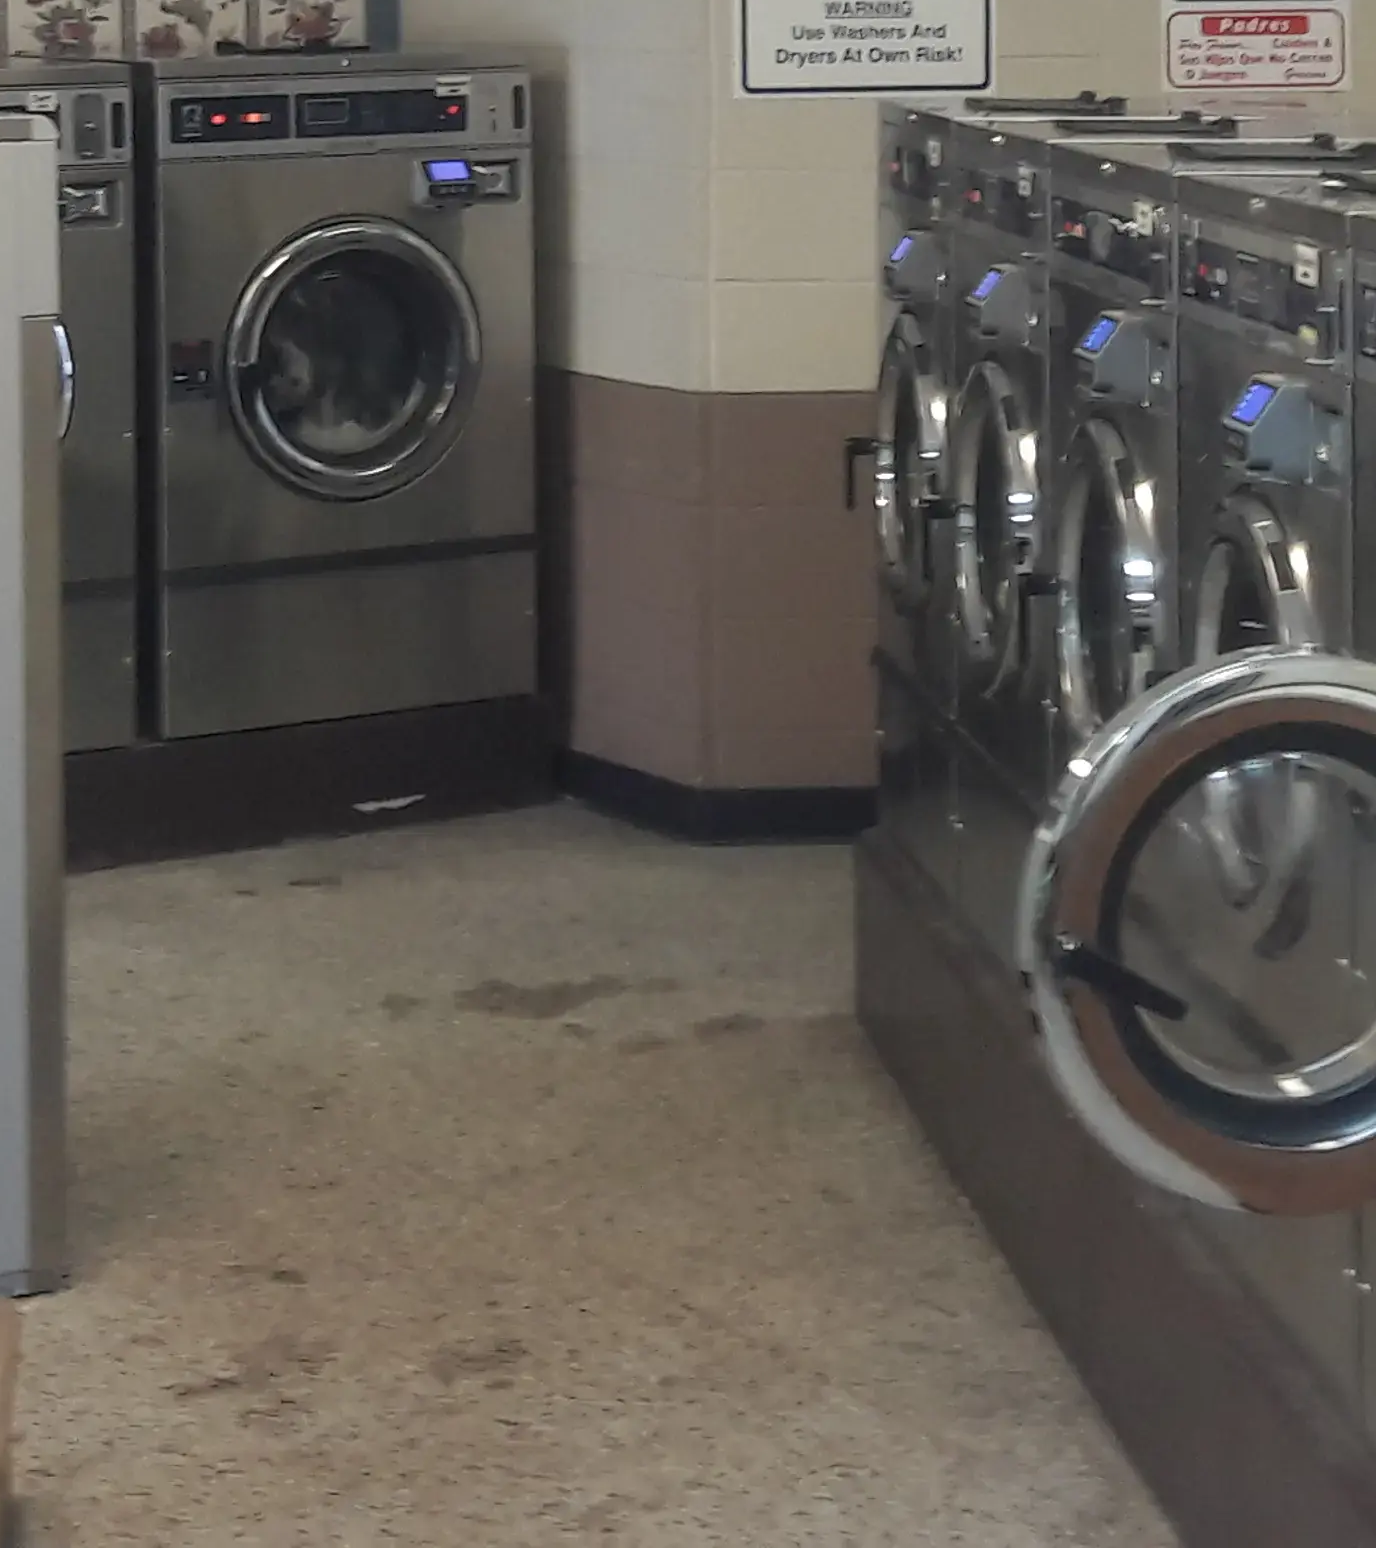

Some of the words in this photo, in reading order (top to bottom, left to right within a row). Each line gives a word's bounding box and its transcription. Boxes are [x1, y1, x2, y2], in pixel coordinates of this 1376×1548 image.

[825, 1, 913, 17] WARNING
[792, 25, 825, 40] Use
[831, 25, 906, 40] Washers
[910, 24, 947, 39] And
[1218, 17, 1291, 34] Padres
[775, 49, 837, 68] Dryers
[843, 48, 863, 63] At
[869, 48, 910, 63] Own
[916, 46, 964, 63] Risk!
